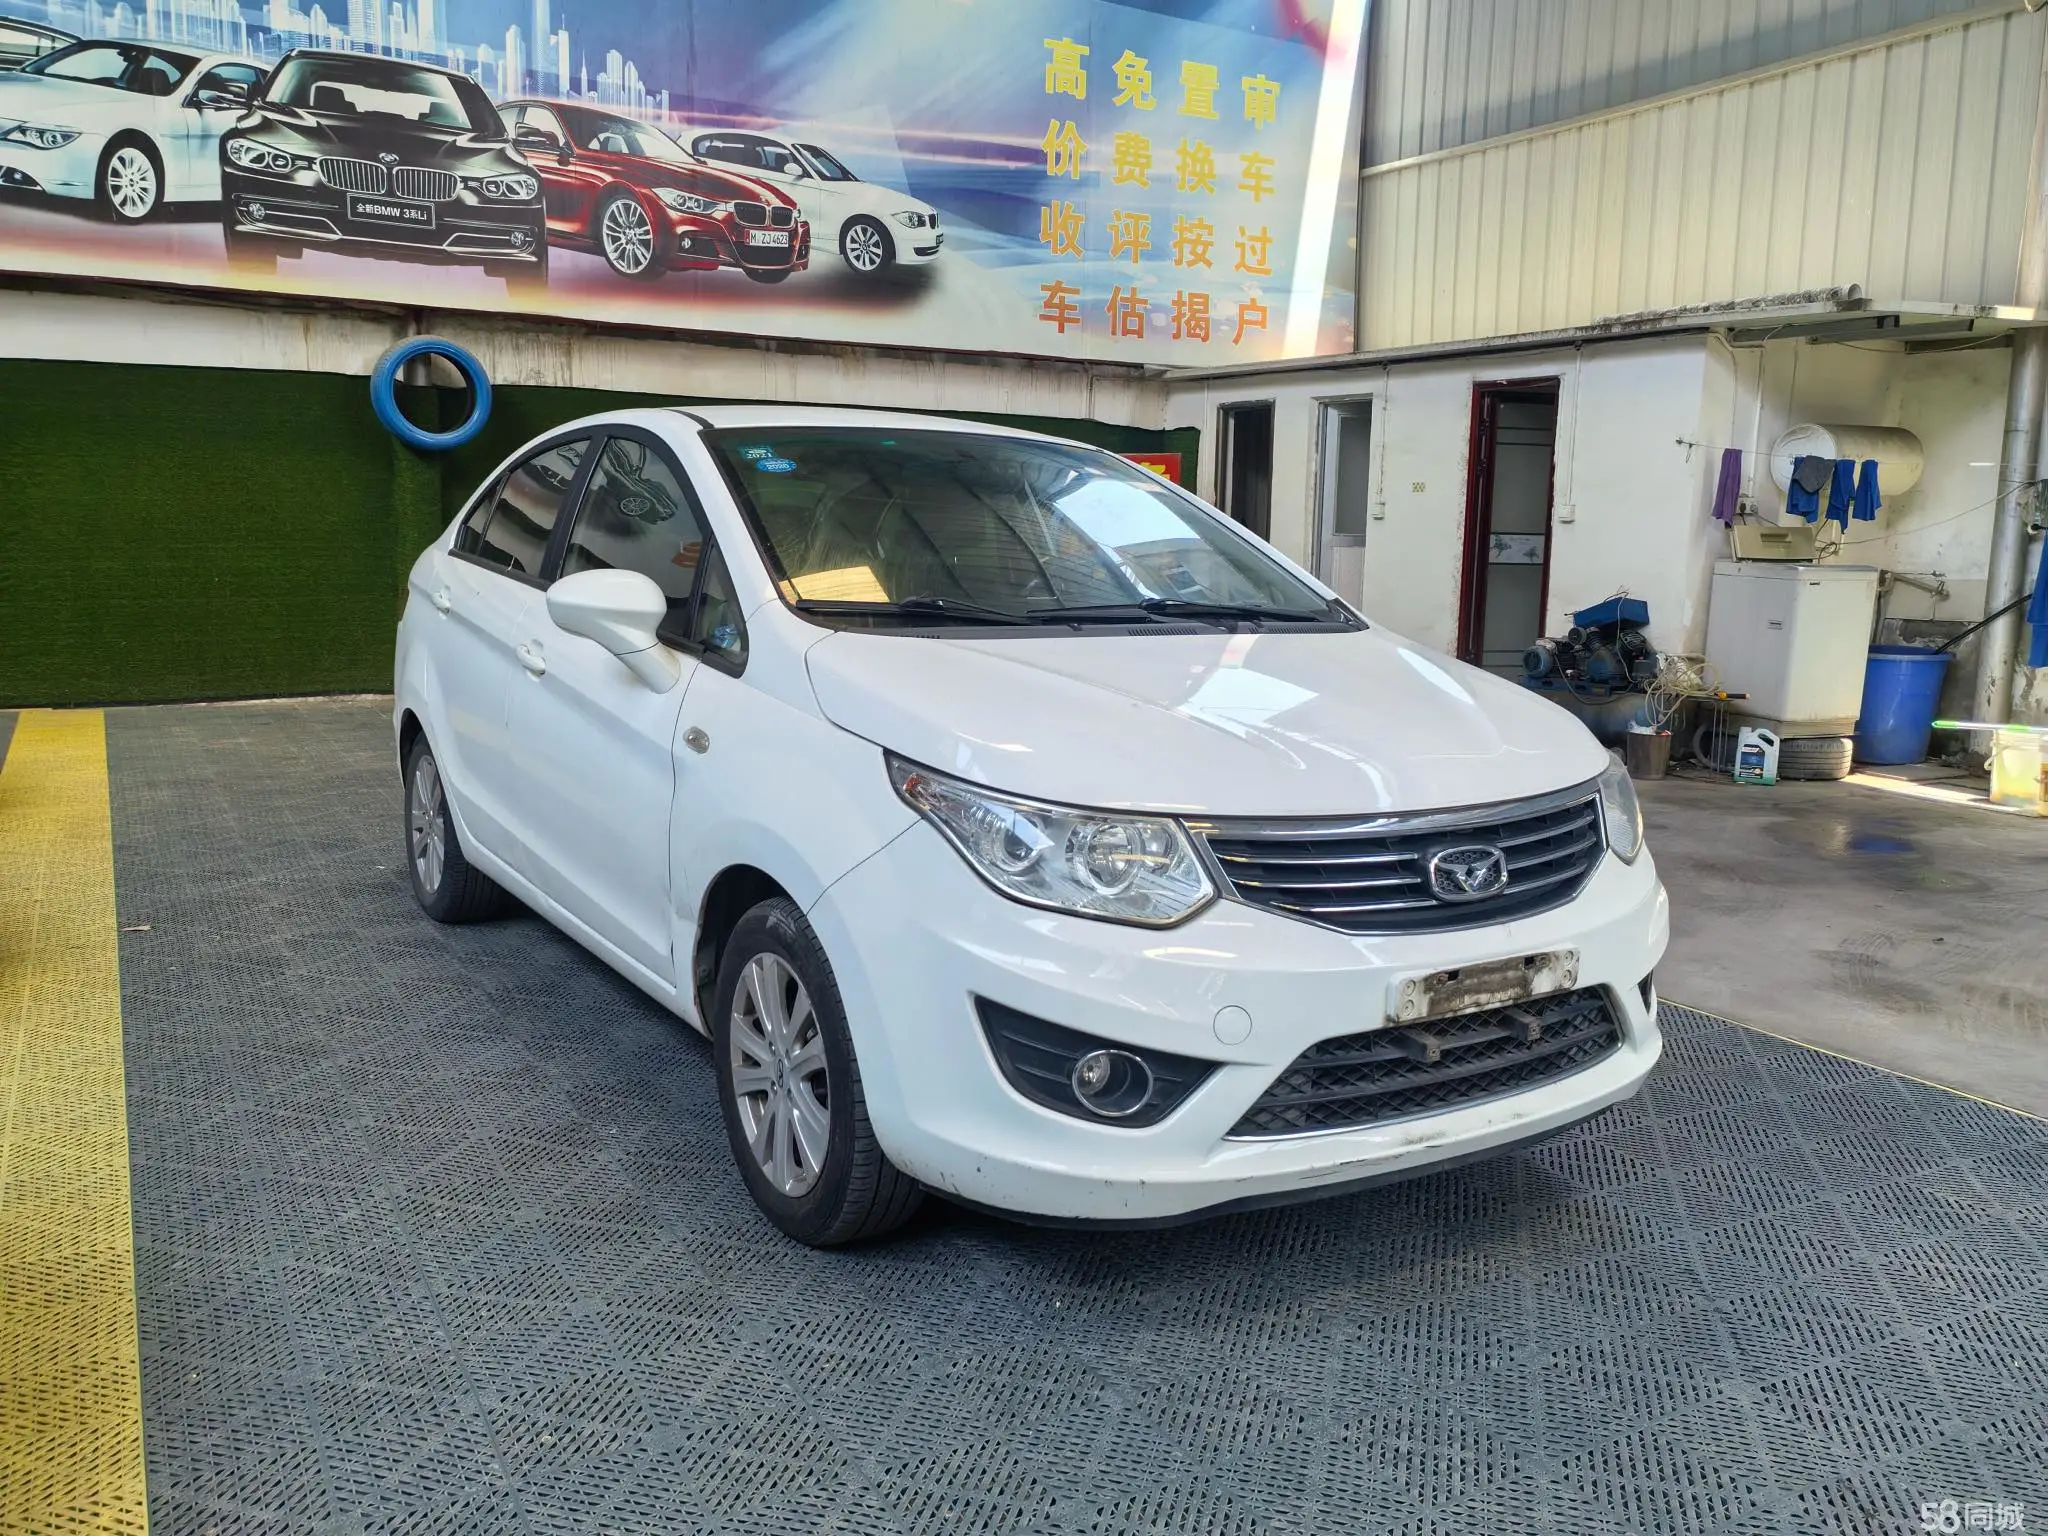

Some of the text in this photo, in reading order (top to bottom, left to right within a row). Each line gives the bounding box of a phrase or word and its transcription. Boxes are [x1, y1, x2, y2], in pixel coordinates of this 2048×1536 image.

[356, 203, 401, 217] 全新BMW
[1038, 37, 1090, 334] 高价收车
[1105, 48, 1157, 340] 免费评估
[1171, 60, 1220, 343] 置换按揭
[1232, 73, 1281, 346] 审车过户
